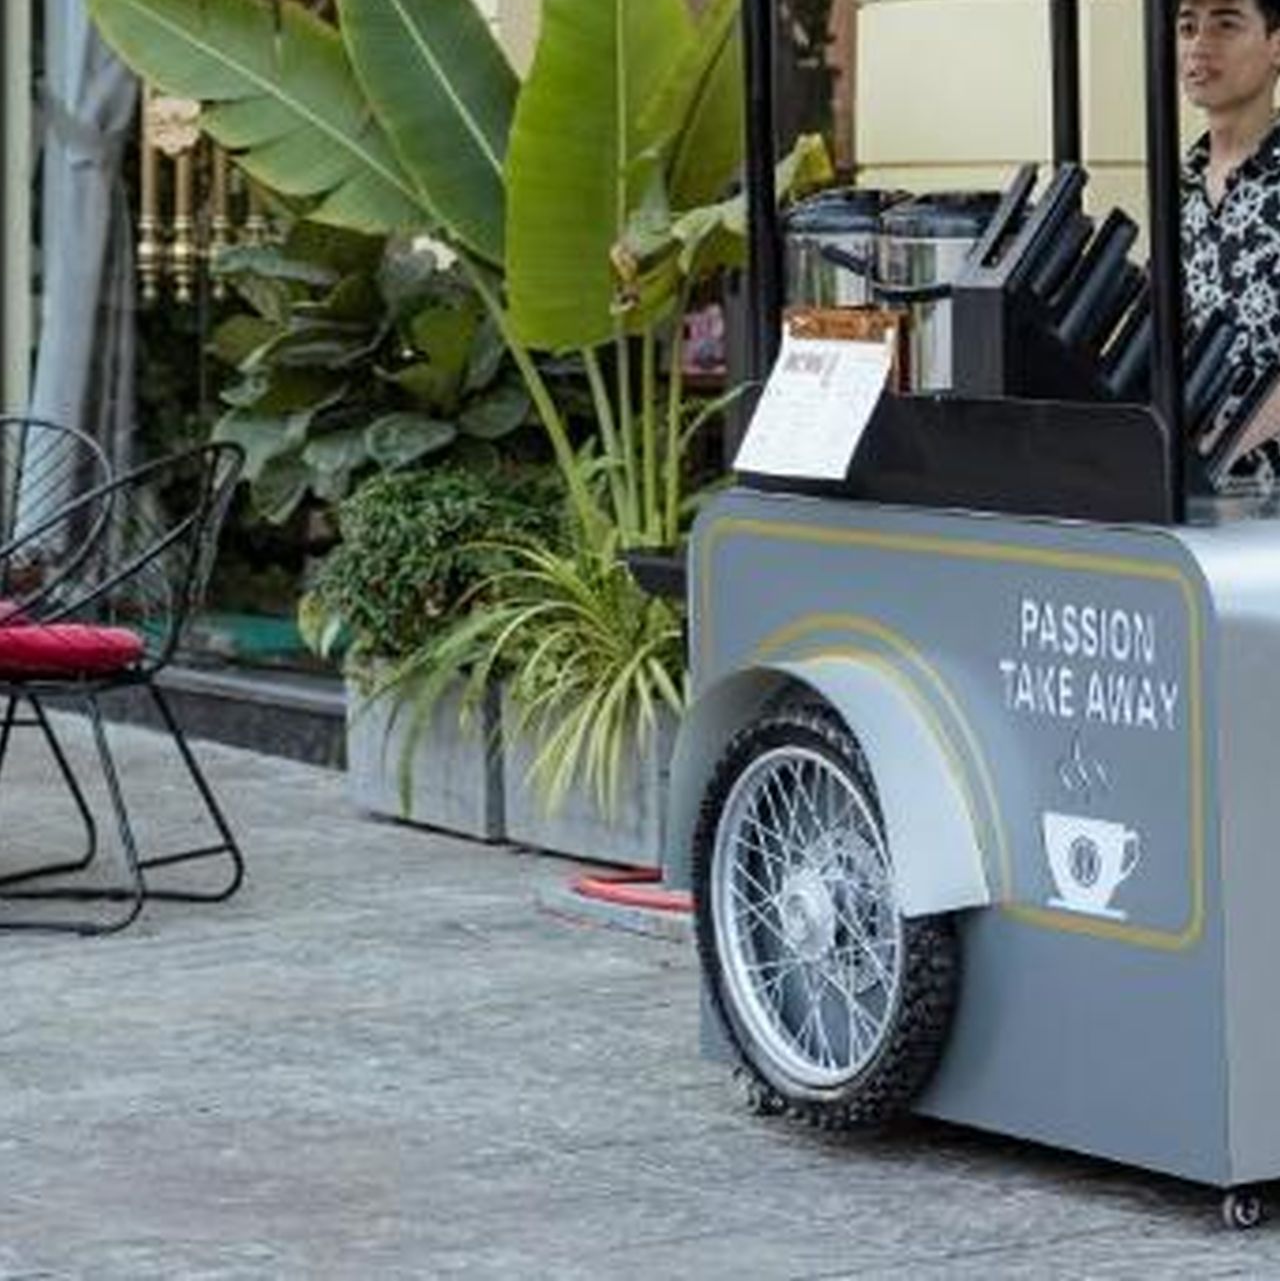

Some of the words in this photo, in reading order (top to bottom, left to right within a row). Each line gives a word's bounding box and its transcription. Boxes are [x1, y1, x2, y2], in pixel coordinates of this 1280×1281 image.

[1020, 598, 1156, 664] PASSION
[999, 659, 1075, 718] TAKE
[1085, 669, 1179, 730] AWAY
